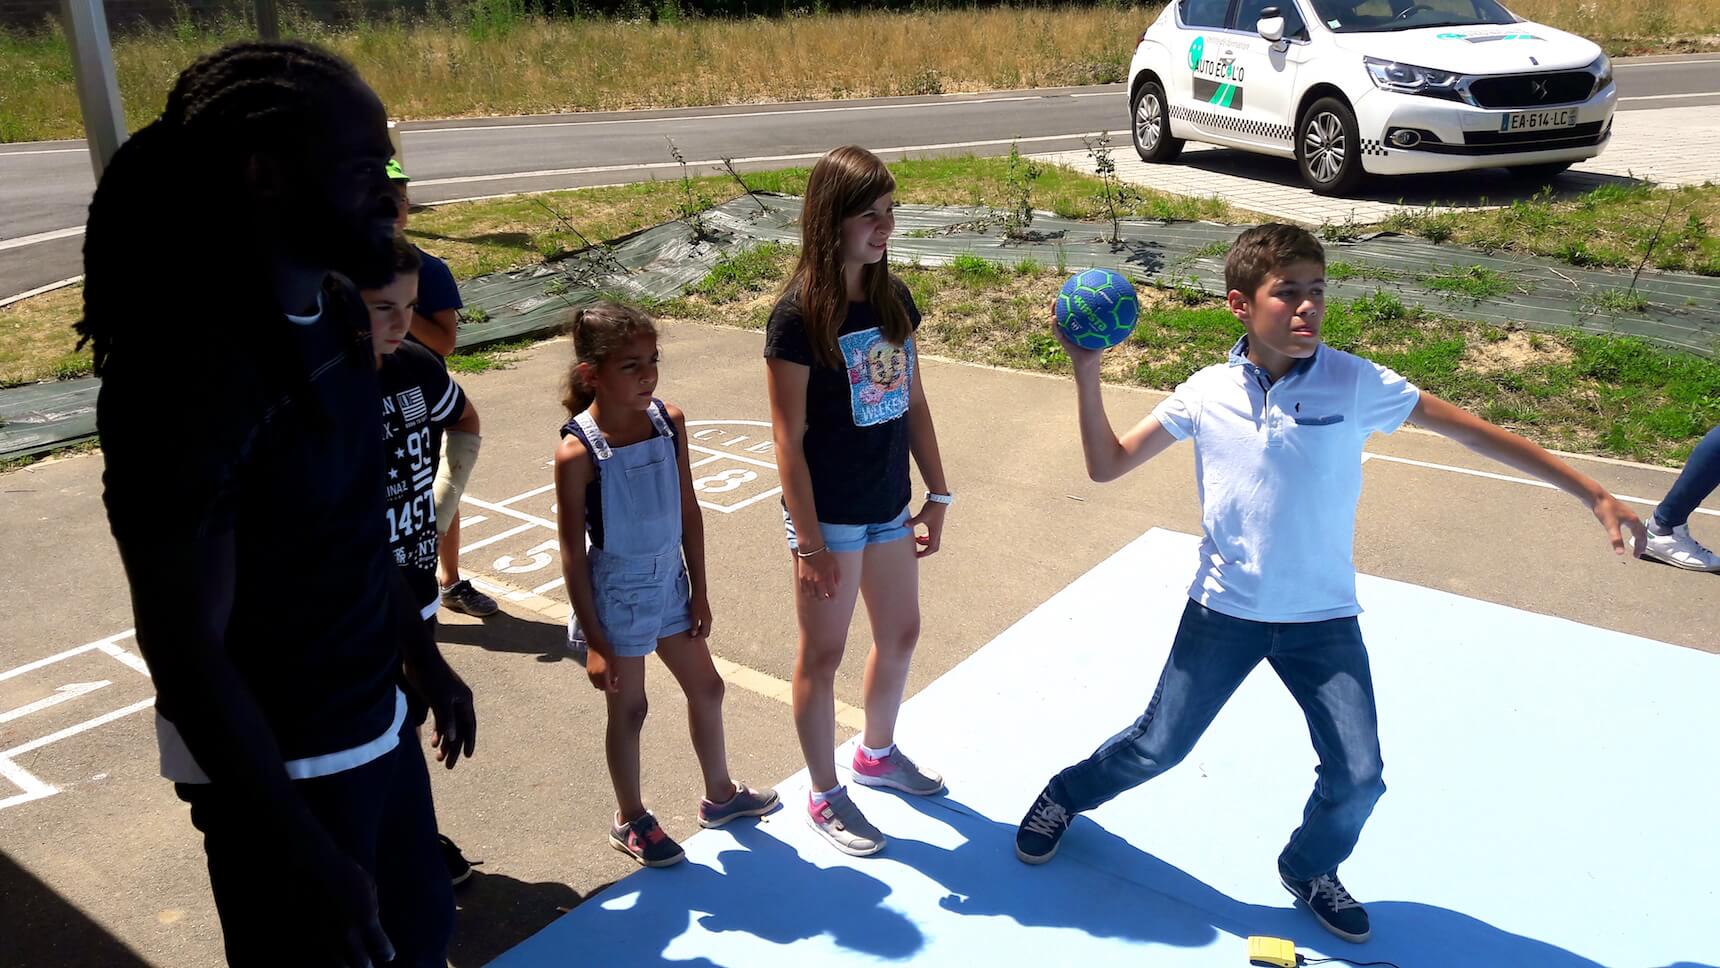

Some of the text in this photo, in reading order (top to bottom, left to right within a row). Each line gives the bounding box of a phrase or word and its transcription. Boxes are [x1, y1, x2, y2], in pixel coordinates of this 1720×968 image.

[1196, 59, 1214, 75] AUTO
[692, 468, 758, 493] 8
[417, 538, 436, 556] NY
